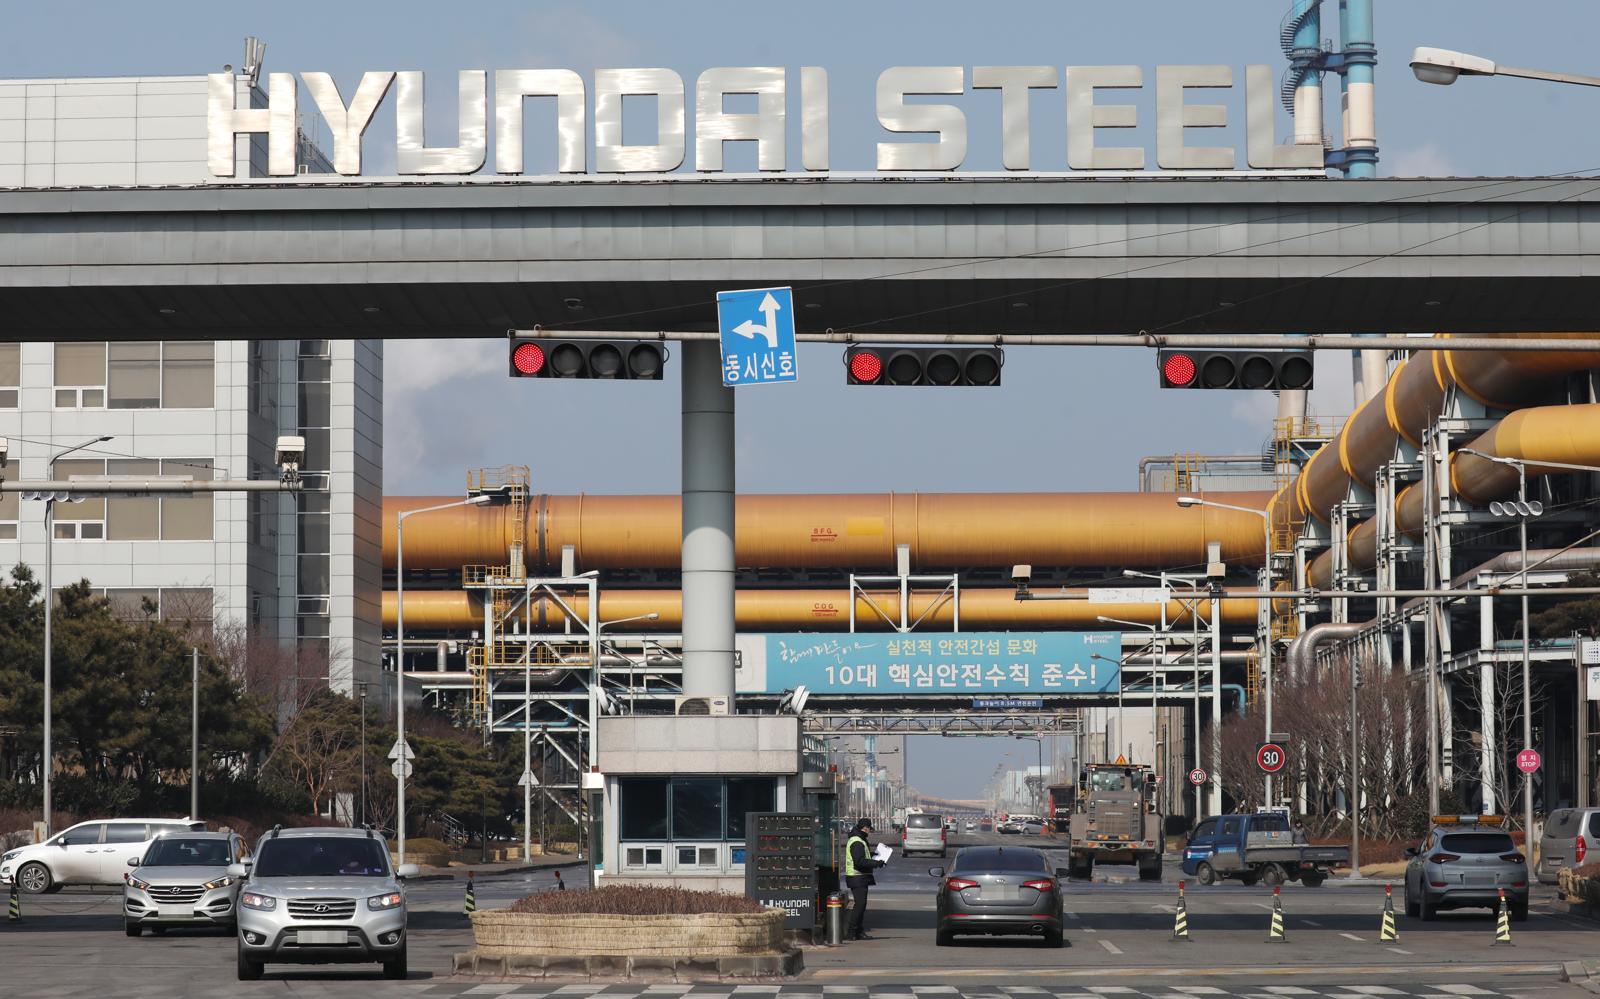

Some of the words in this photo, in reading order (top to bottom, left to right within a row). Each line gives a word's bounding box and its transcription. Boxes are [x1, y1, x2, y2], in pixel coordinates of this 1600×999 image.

[207, 66, 829, 177] HYUNDAI
[876, 64, 1325, 171] STEEL
[725, 351, 795, 381] 동시신호
[886, 639, 932, 656] 실천적
[938, 639, 1000, 656] 안전간섭
[1007, 639, 1038, 655] 문화
[825, 663, 877, 688] 10대
[888, 663, 1030, 688] 핵심안전수칙
[1041, 663, 1096, 688] 준수!
[1263, 751, 1279, 765] 30
[1193, 772, 1203, 781] 30
[775, 899, 810, 908] HYUNDAI
